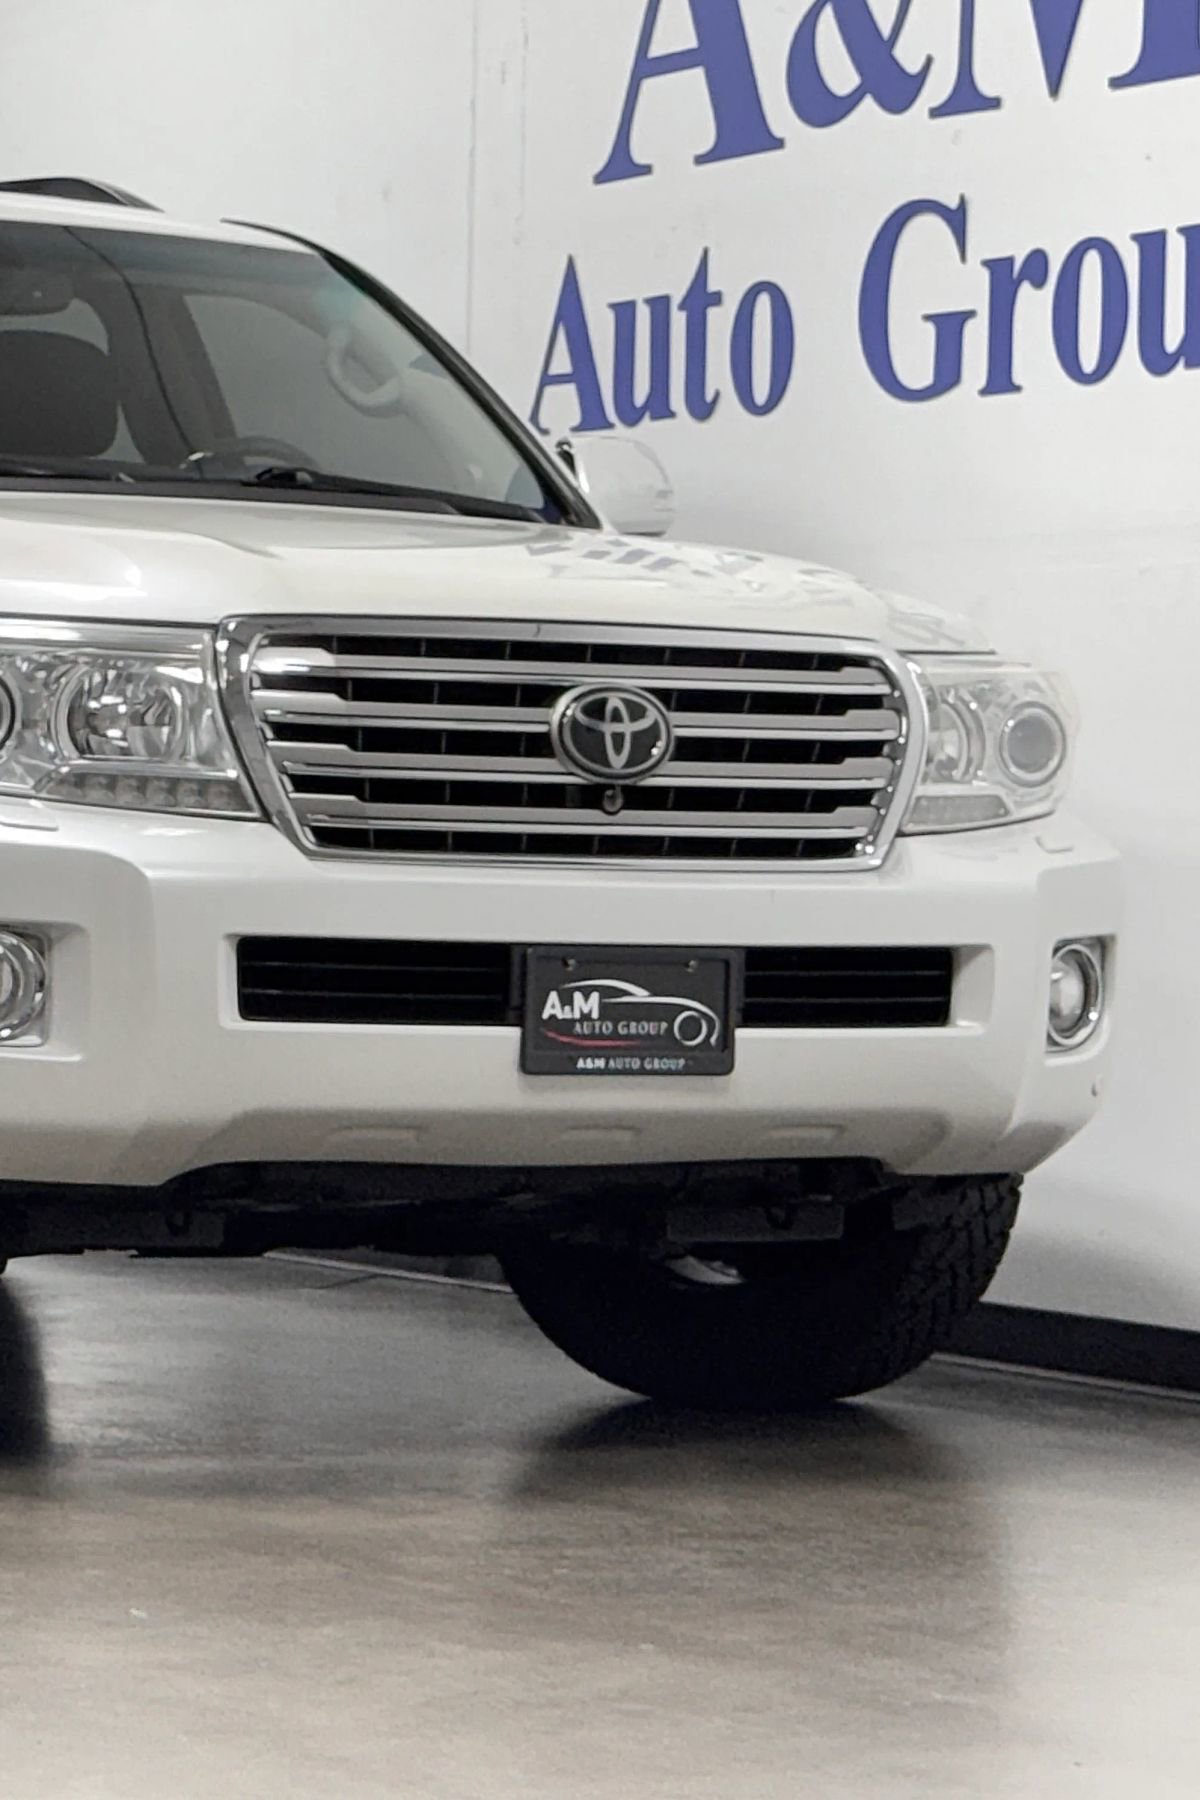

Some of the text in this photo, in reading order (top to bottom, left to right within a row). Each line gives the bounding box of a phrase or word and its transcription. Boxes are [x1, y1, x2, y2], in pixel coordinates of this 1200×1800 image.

[528, 246, 794, 435] Auto
[541, 990, 600, 1020] A&M
[573, 1021, 669, 1036] AUTO GROUP
[576, 1056, 686, 1070] A&M AUTO GROUP
